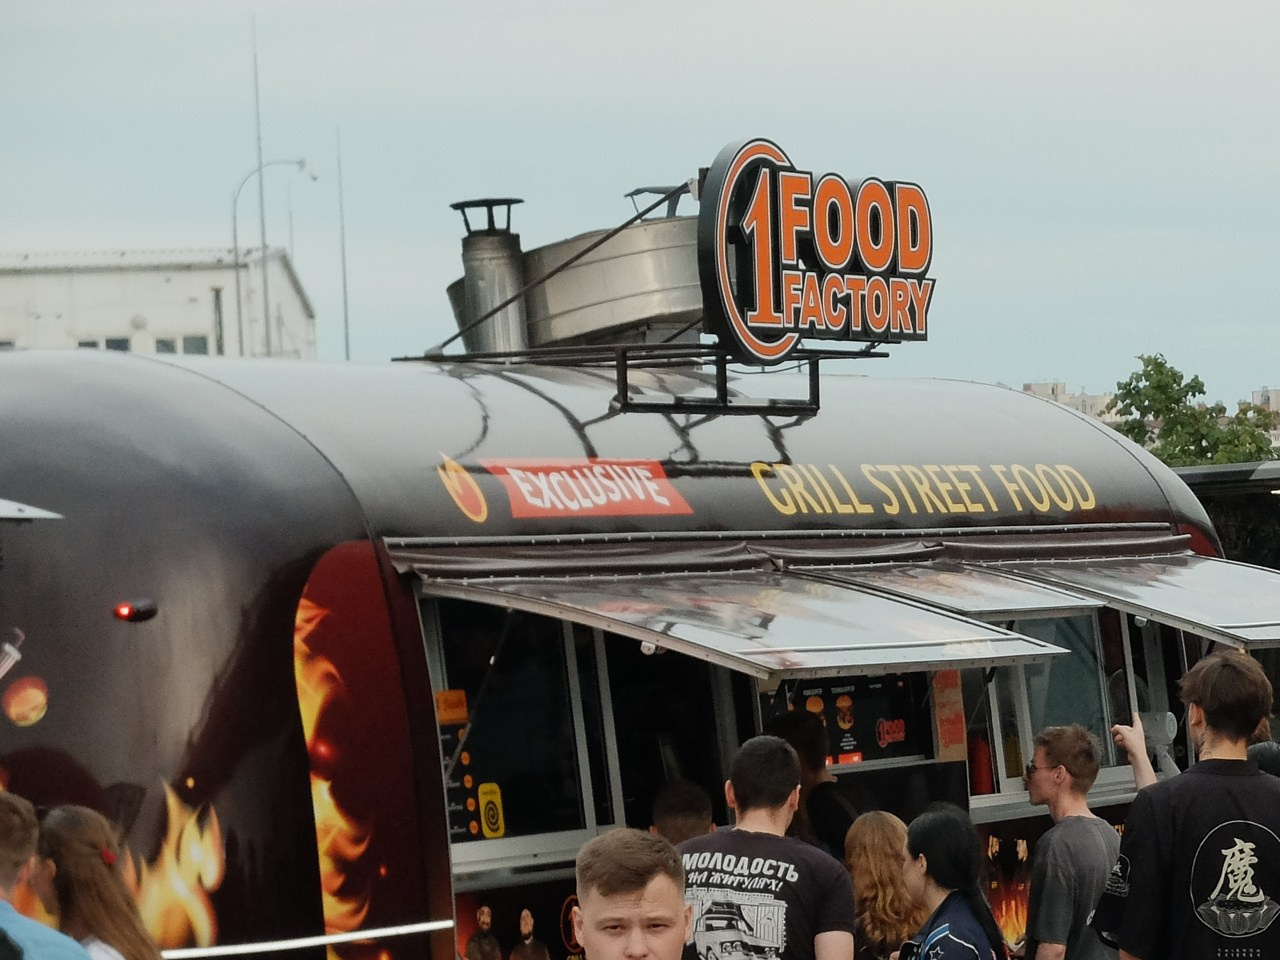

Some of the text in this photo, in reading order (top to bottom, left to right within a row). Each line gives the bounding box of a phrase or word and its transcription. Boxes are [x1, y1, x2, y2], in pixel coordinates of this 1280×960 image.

[743, 167, 931, 328] 1 FOOD
[782, 270, 934, 334] FACTORY
[505, 464, 671, 511] EXCLUSIVE
[750, 462, 1096, 515] GRILL STREET FOOD
[682, 852, 799, 883] МОЛОДОСТЬ
[1210, 837, 1265, 903] 魔
